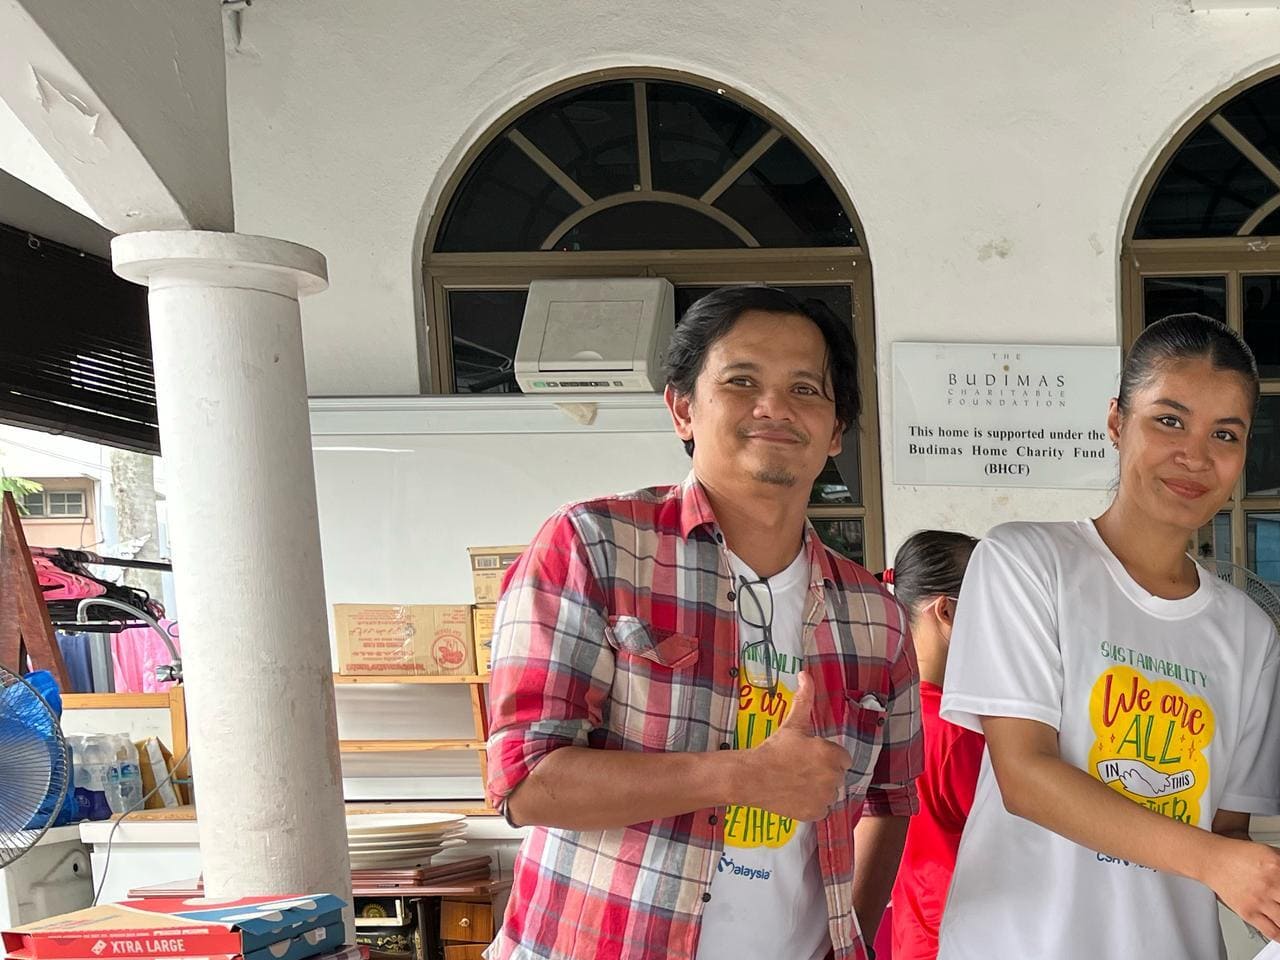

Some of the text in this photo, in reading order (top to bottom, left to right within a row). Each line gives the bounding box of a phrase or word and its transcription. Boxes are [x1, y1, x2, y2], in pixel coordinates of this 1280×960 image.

[992, 353, 1021, 361] THE
[948, 373, 1066, 388] BUDIMAS
[947, 389, 1065, 398] CHARITABLE
[947, 399, 1066, 408] FOUNDATION
[908, 426, 1106, 444] This home is supported under the
[909, 444, 1105, 460] Budimas Home Charity Fund
[984, 464, 1030, 476] (BHCF)
[1101, 640, 1208, 688] SUSTAINABILITY
[1102, 674, 1206, 735] We are
[1116, 714, 1181, 765] ALL
[1105, 762, 1120, 778] IN
[110, 939, 186, 954] XTRA LARGE
